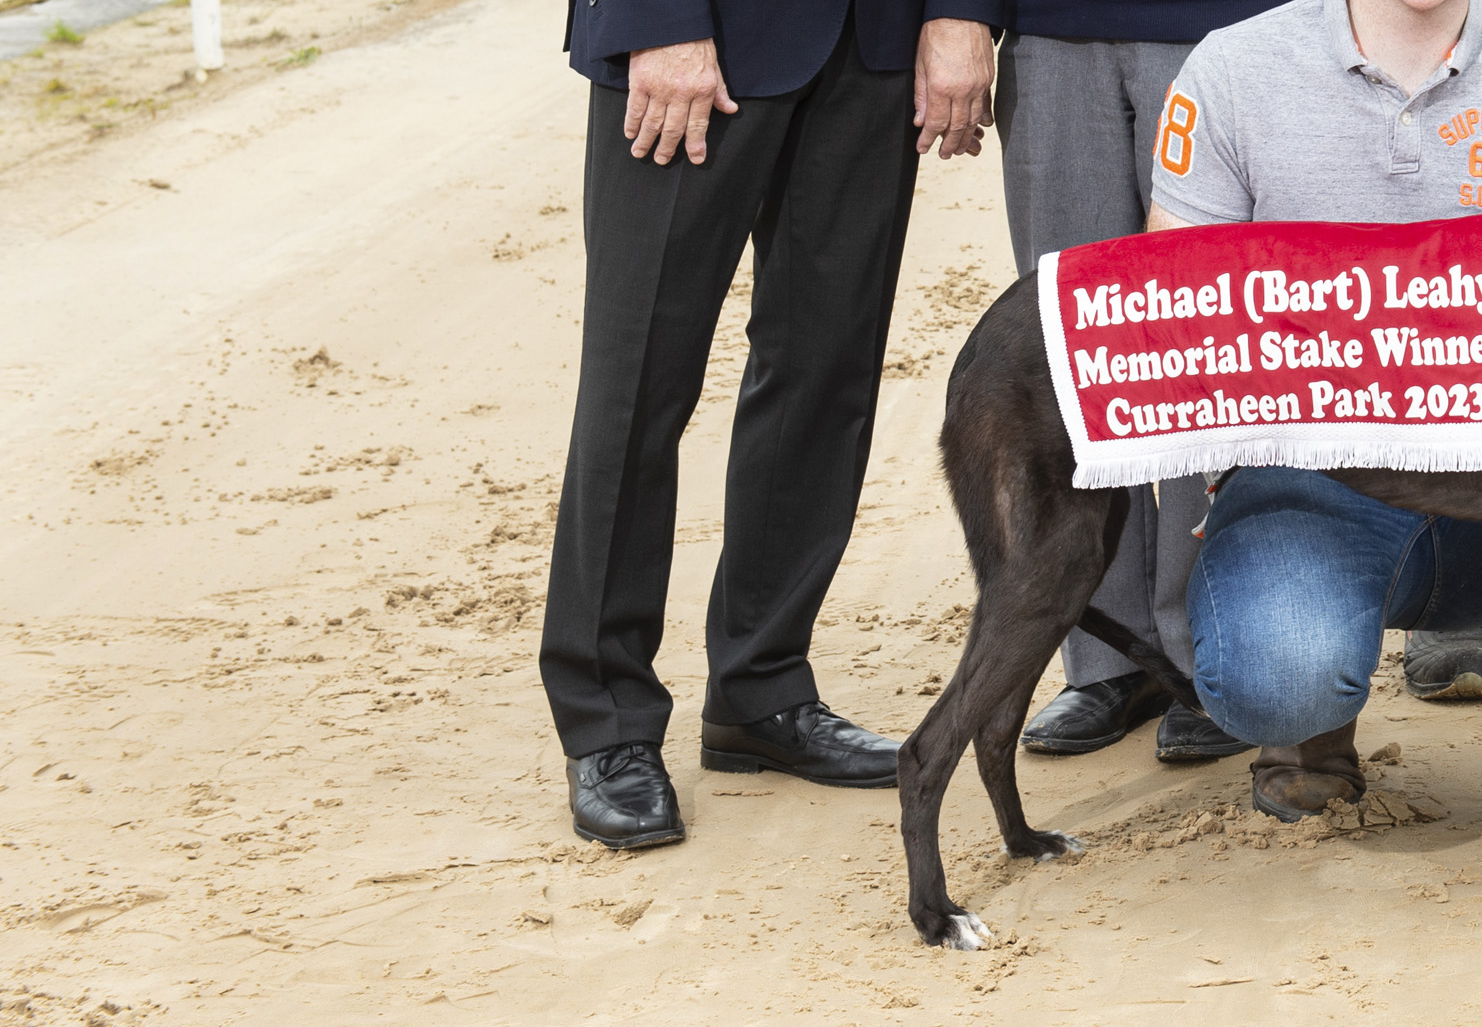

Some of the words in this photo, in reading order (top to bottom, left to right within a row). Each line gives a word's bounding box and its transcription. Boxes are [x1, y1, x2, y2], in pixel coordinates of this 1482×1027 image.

[1073, 273, 1233, 332] Michael
[1243, 266, 1372, 324] (Bart)
[1073, 333, 1253, 390] Memorial
[1259, 331, 1364, 370] Stake
[1106, 390, 1302, 437] Curraheen
[1307, 381, 1397, 420] Park
